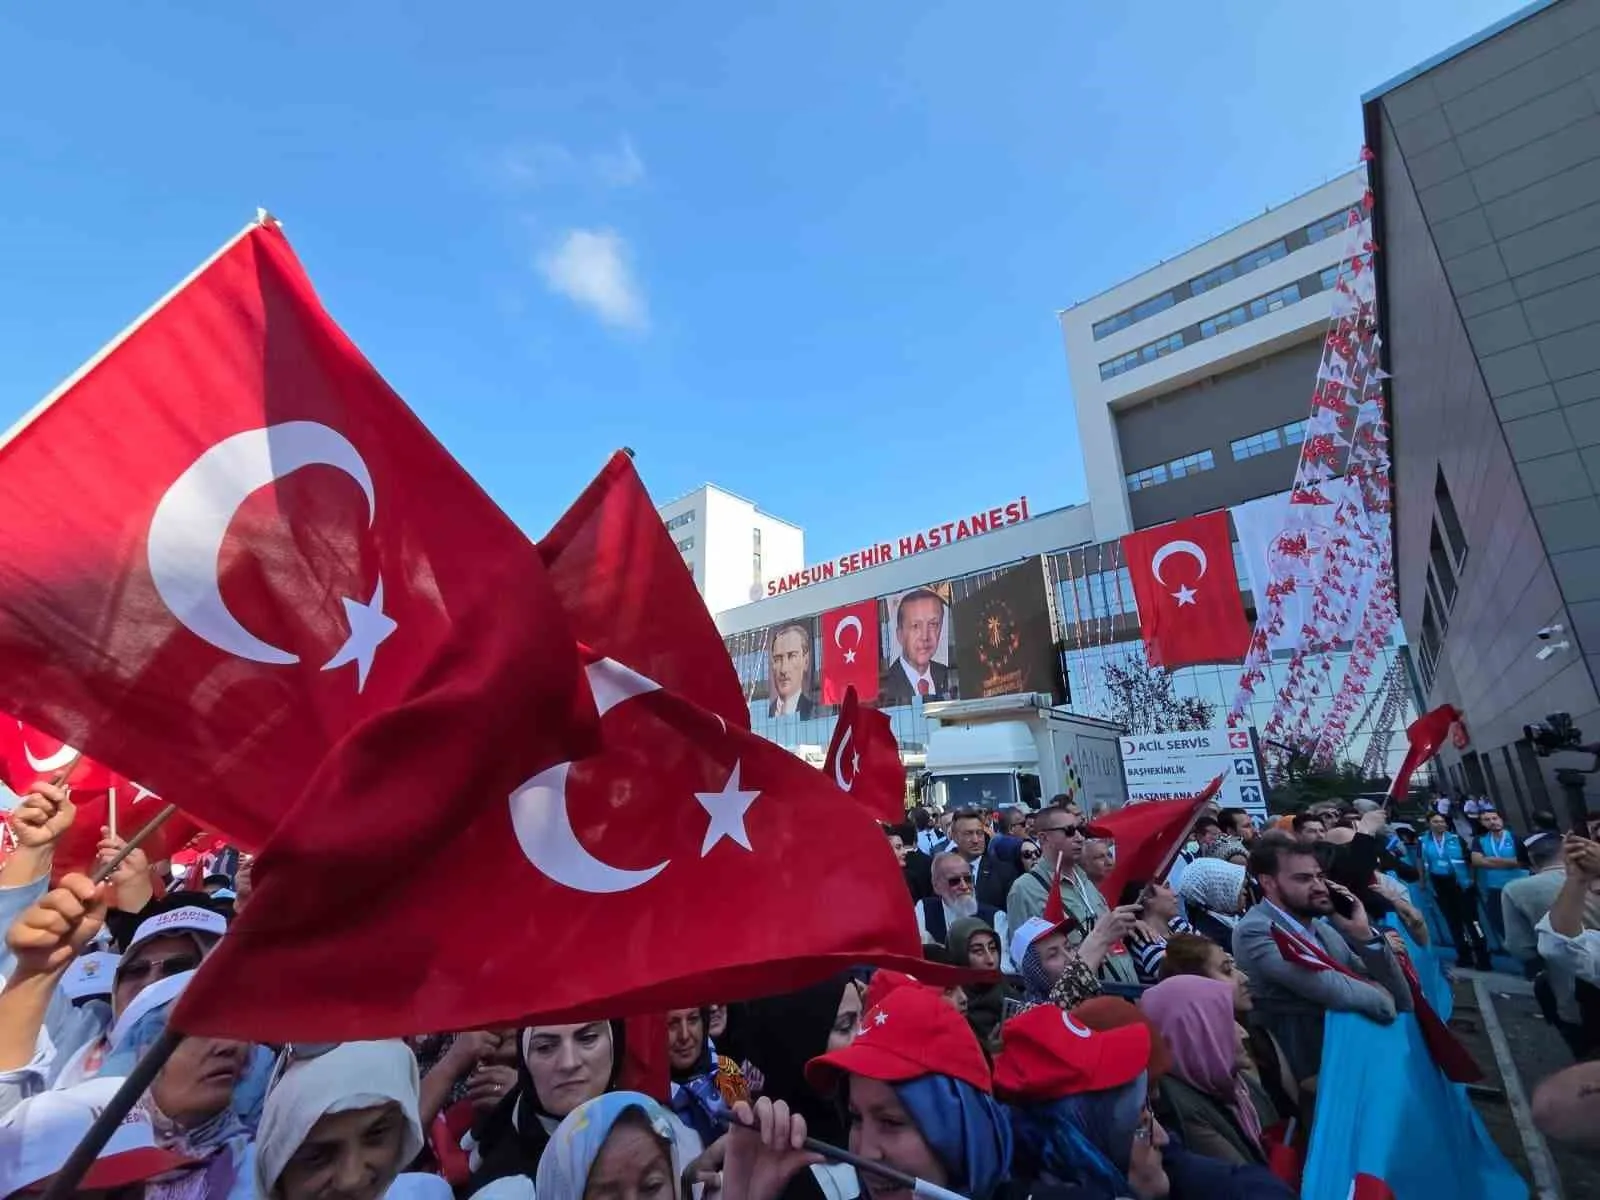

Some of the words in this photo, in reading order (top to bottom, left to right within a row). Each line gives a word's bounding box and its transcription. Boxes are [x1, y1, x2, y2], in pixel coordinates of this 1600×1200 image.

[767, 561, 834, 596] SAMSUN
[899, 496, 1029, 556] HASTANESİ
[1166, 736, 1210, 750] SERVİS
